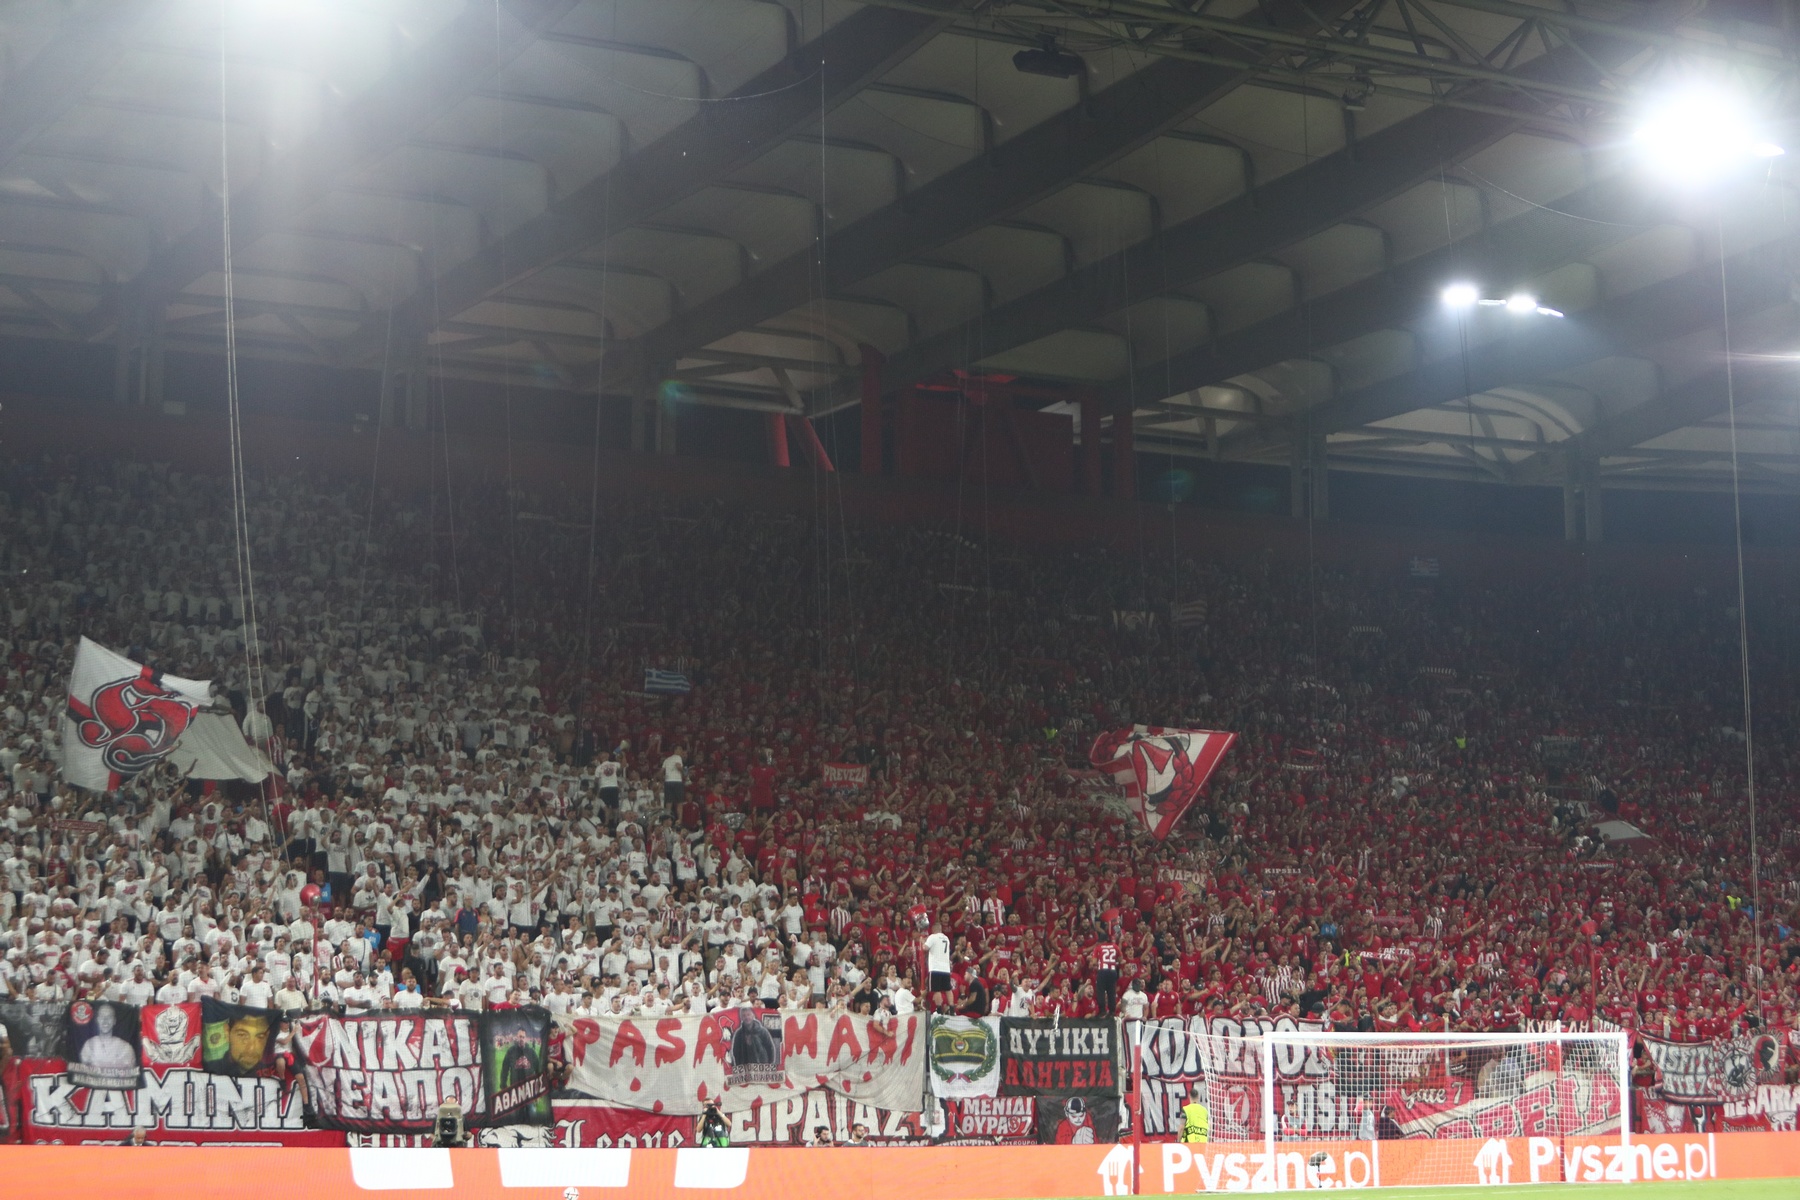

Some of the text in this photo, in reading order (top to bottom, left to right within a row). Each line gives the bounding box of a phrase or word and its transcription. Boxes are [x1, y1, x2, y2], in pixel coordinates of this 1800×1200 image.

[823, 763, 868, 782] PREVEZA
[942, 940, 948, 954] 7
[1102, 948, 1116, 962] 22
[329, 1018, 481, 1069] ΝΙΚΑΙ
[1009, 1027, 1109, 1055] ΔΥΤΙΚΗ
[1451, 1082, 1465, 1104] 7
[697, 1090, 922, 1143] ΕΙΡΑΙΑΣ
[1163, 1140, 1379, 1192] Pyszne.pl
[1529, 1133, 1717, 1183] Pyszne.pl
